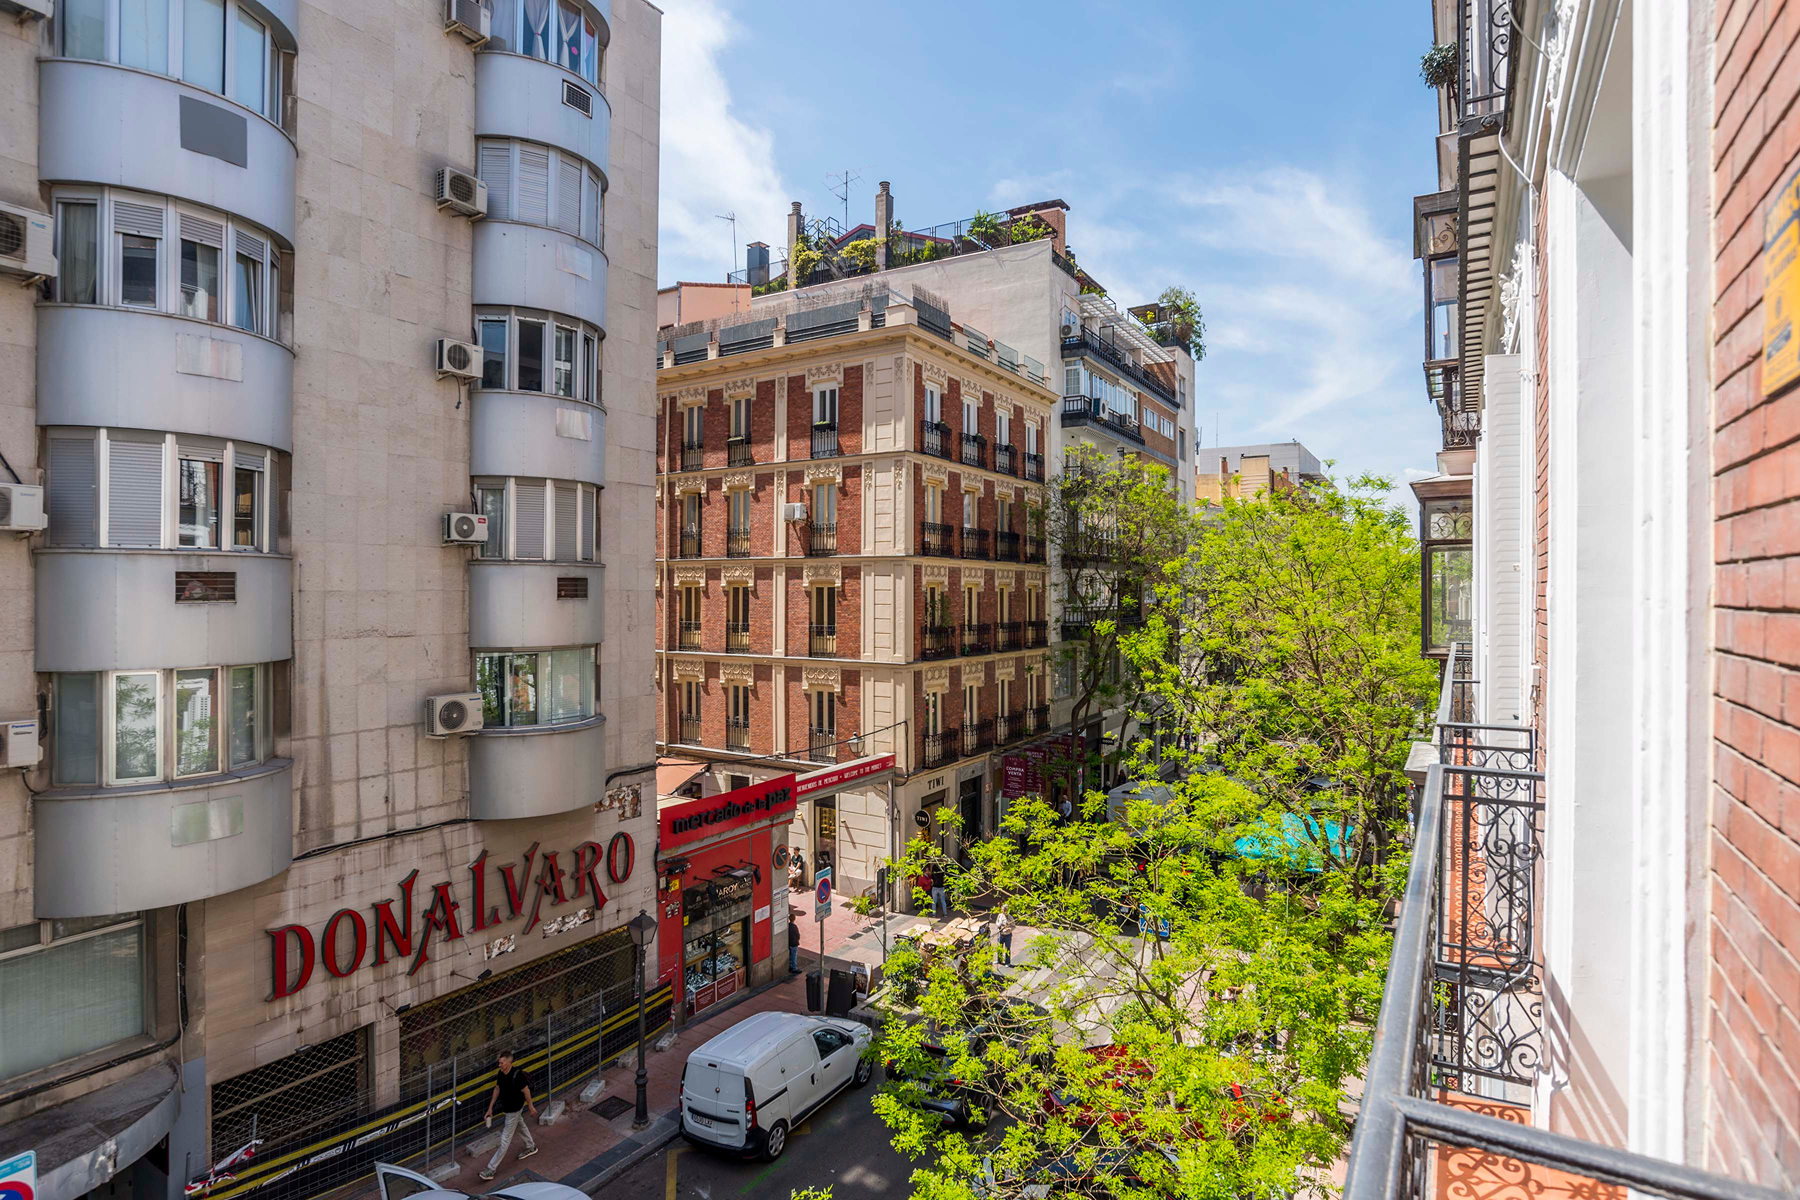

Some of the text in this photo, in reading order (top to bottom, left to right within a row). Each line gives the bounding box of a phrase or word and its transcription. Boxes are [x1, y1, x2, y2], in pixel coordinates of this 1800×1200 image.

[928, 776, 944, 790] TIWI
[672, 787, 791, 834] mercado de la paz
